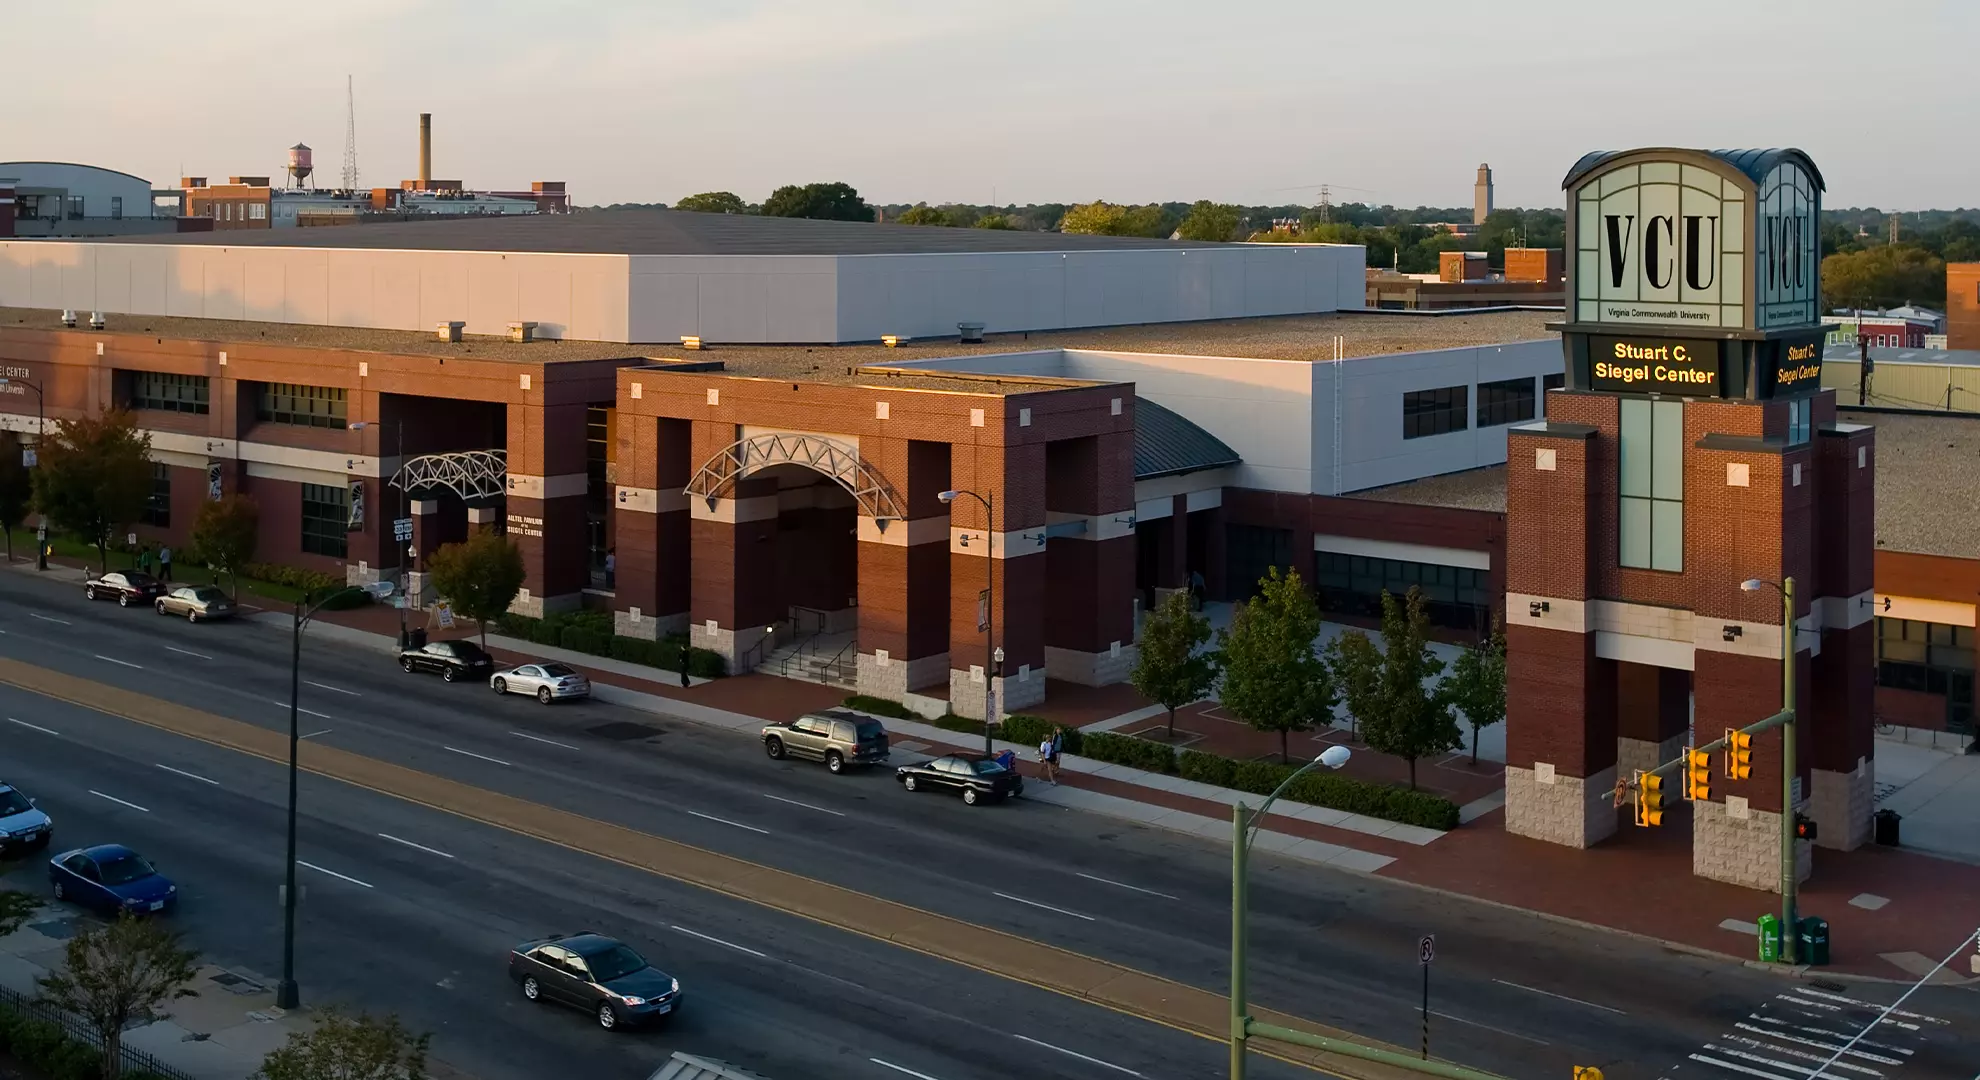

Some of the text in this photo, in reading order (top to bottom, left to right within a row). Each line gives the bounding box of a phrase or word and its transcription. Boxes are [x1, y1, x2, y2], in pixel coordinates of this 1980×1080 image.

[1604, 215, 1719, 291] VCU
[1766, 215, 1807, 291] VCU
[1608, 308, 1711, 321] Virginia Commonwealth University
[1614, 342, 1692, 361] Stuart C.
[1787, 343, 1815, 361] Stuart C.
[6, 366, 30, 379] CENTER
[1595, 362, 1715, 383] Siegel Center
[1778, 365, 1820, 385] Siegel Center
